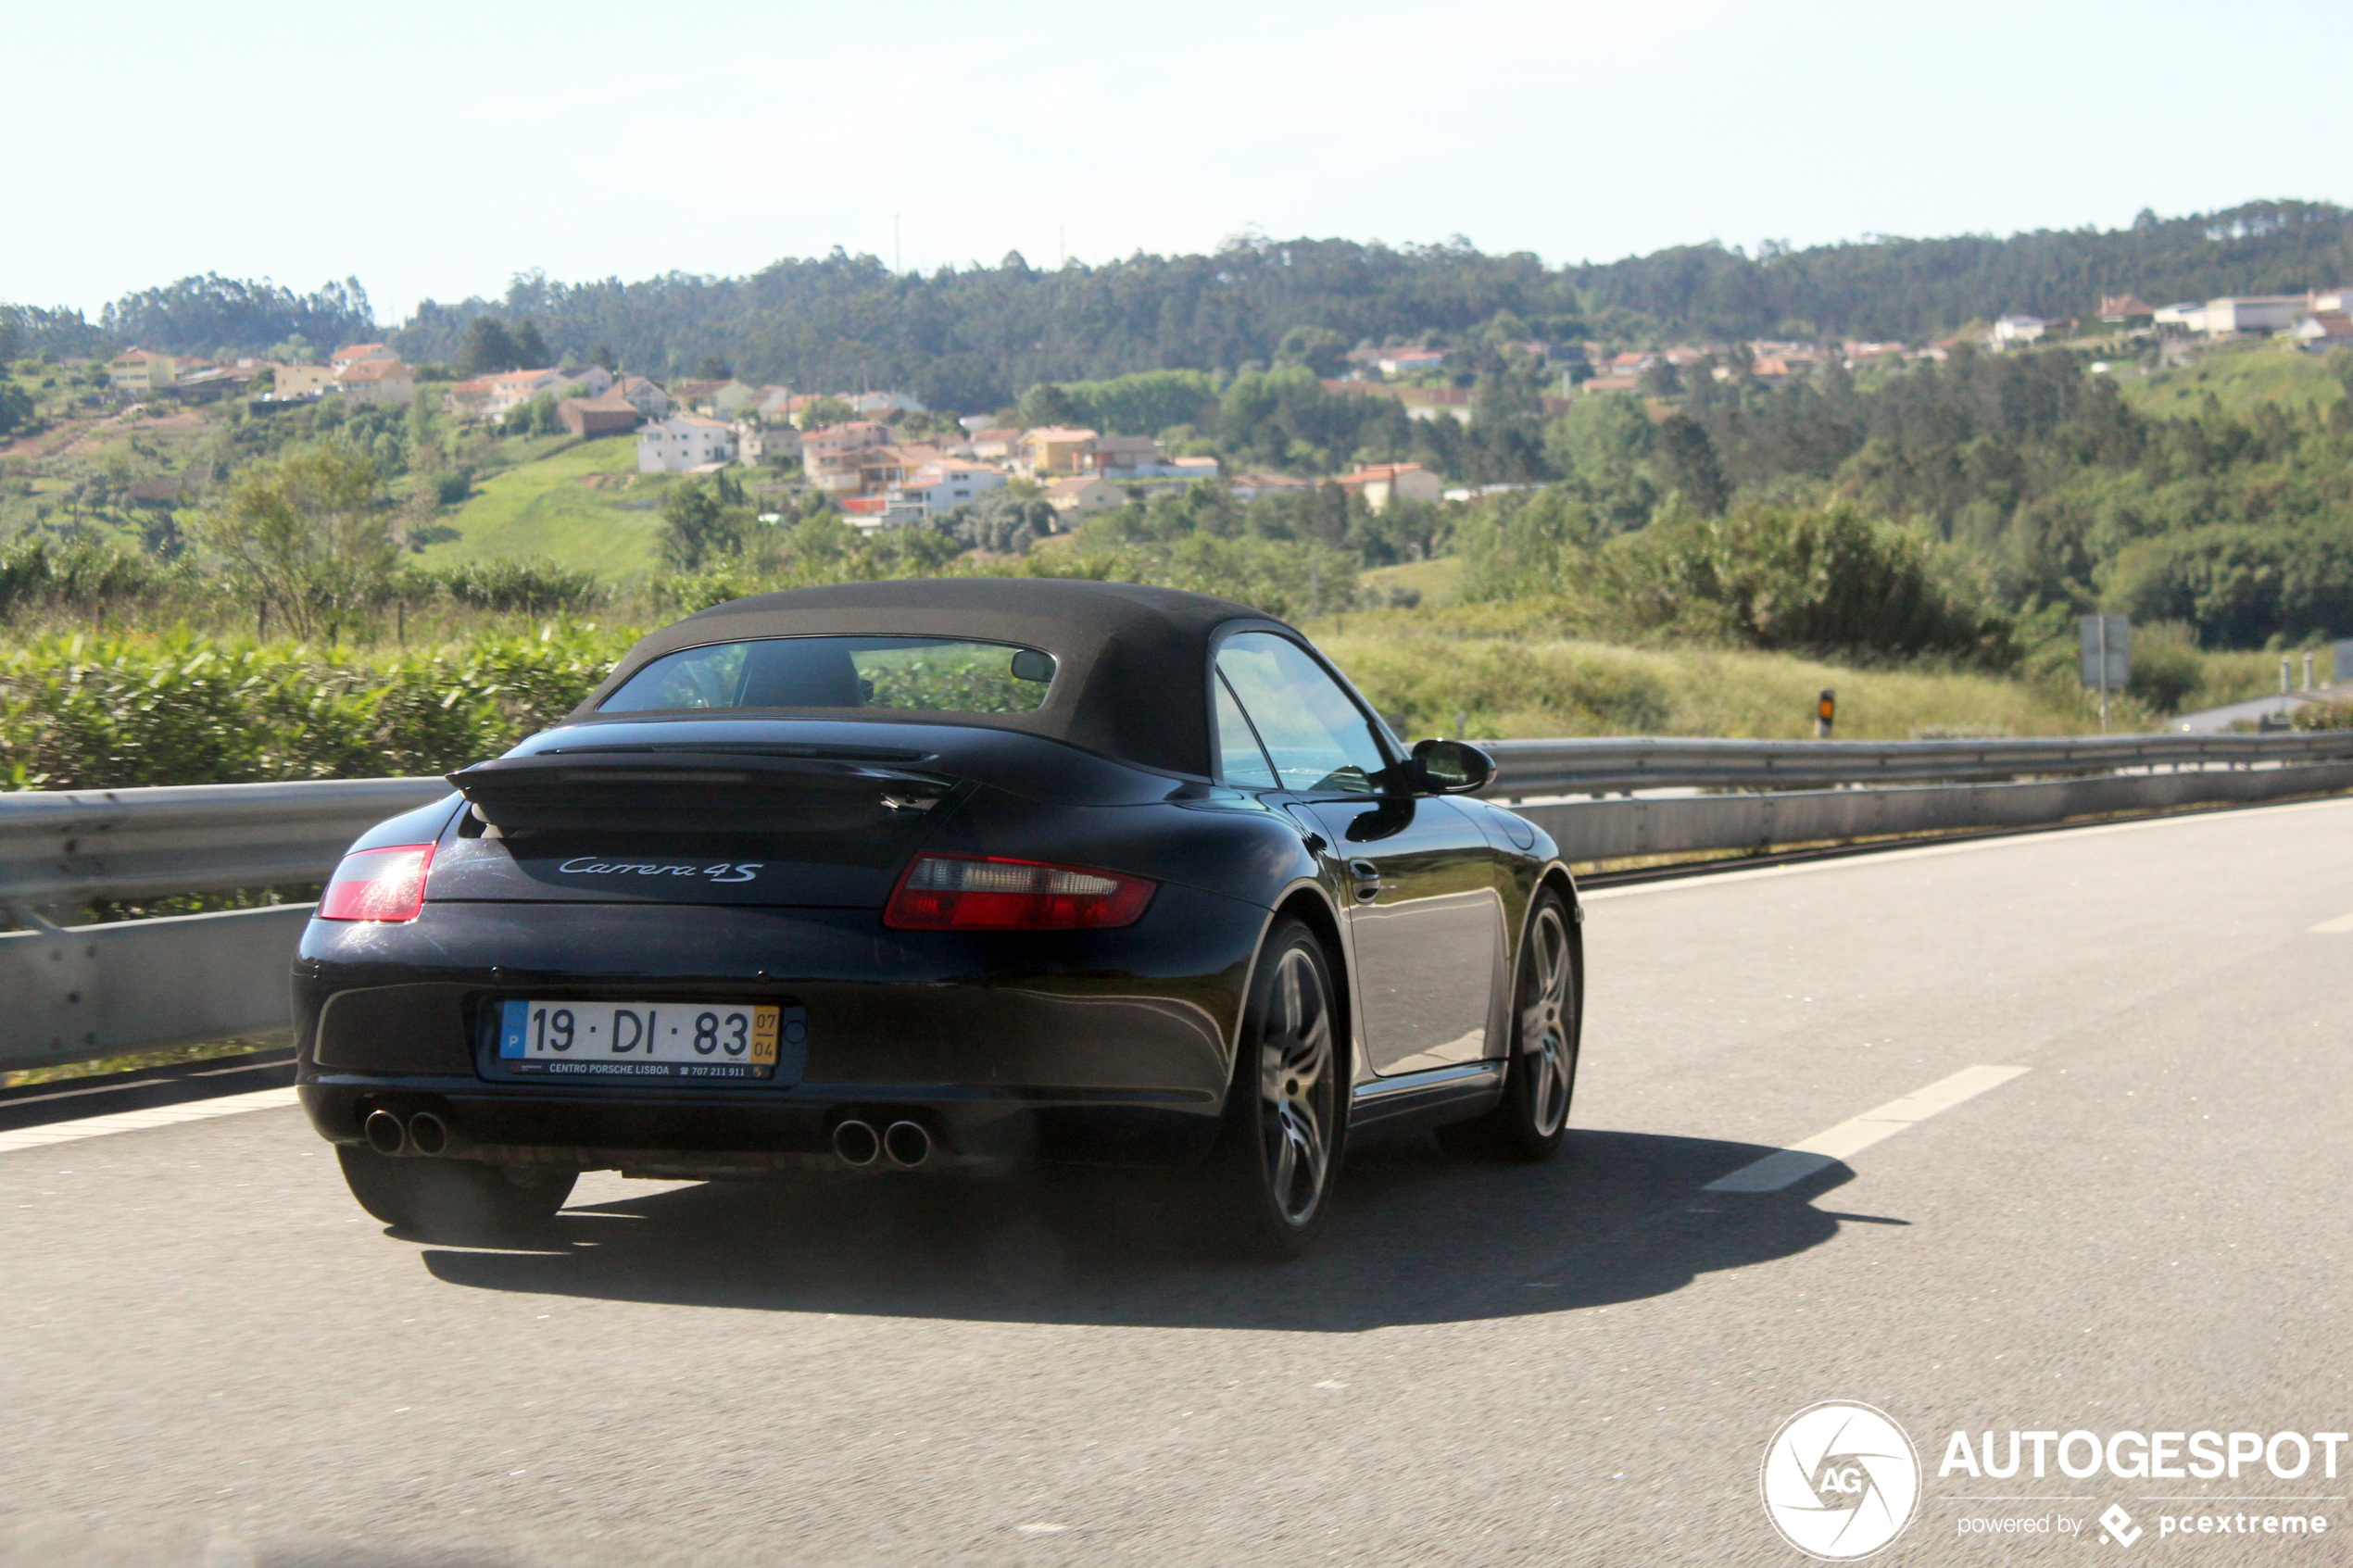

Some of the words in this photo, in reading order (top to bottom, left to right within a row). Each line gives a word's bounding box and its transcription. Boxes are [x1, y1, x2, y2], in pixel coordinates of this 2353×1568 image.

[559, 857, 697, 876] Carrera
[703, 863, 764, 883] 4S
[757, 1014, 775, 1030] 07
[510, 1035, 519, 1048] P
[754, 1042, 774, 1058] 04
[549, 1063, 587, 1073] CENTRO
[589, 1064, 634, 1074] PORSCHE
[635, 1065, 670, 1075] LISBOA
[692, 1067, 708, 1075] 707
[711, 1067, 725, 1076] 211
[729, 1068, 745, 1076] 911
